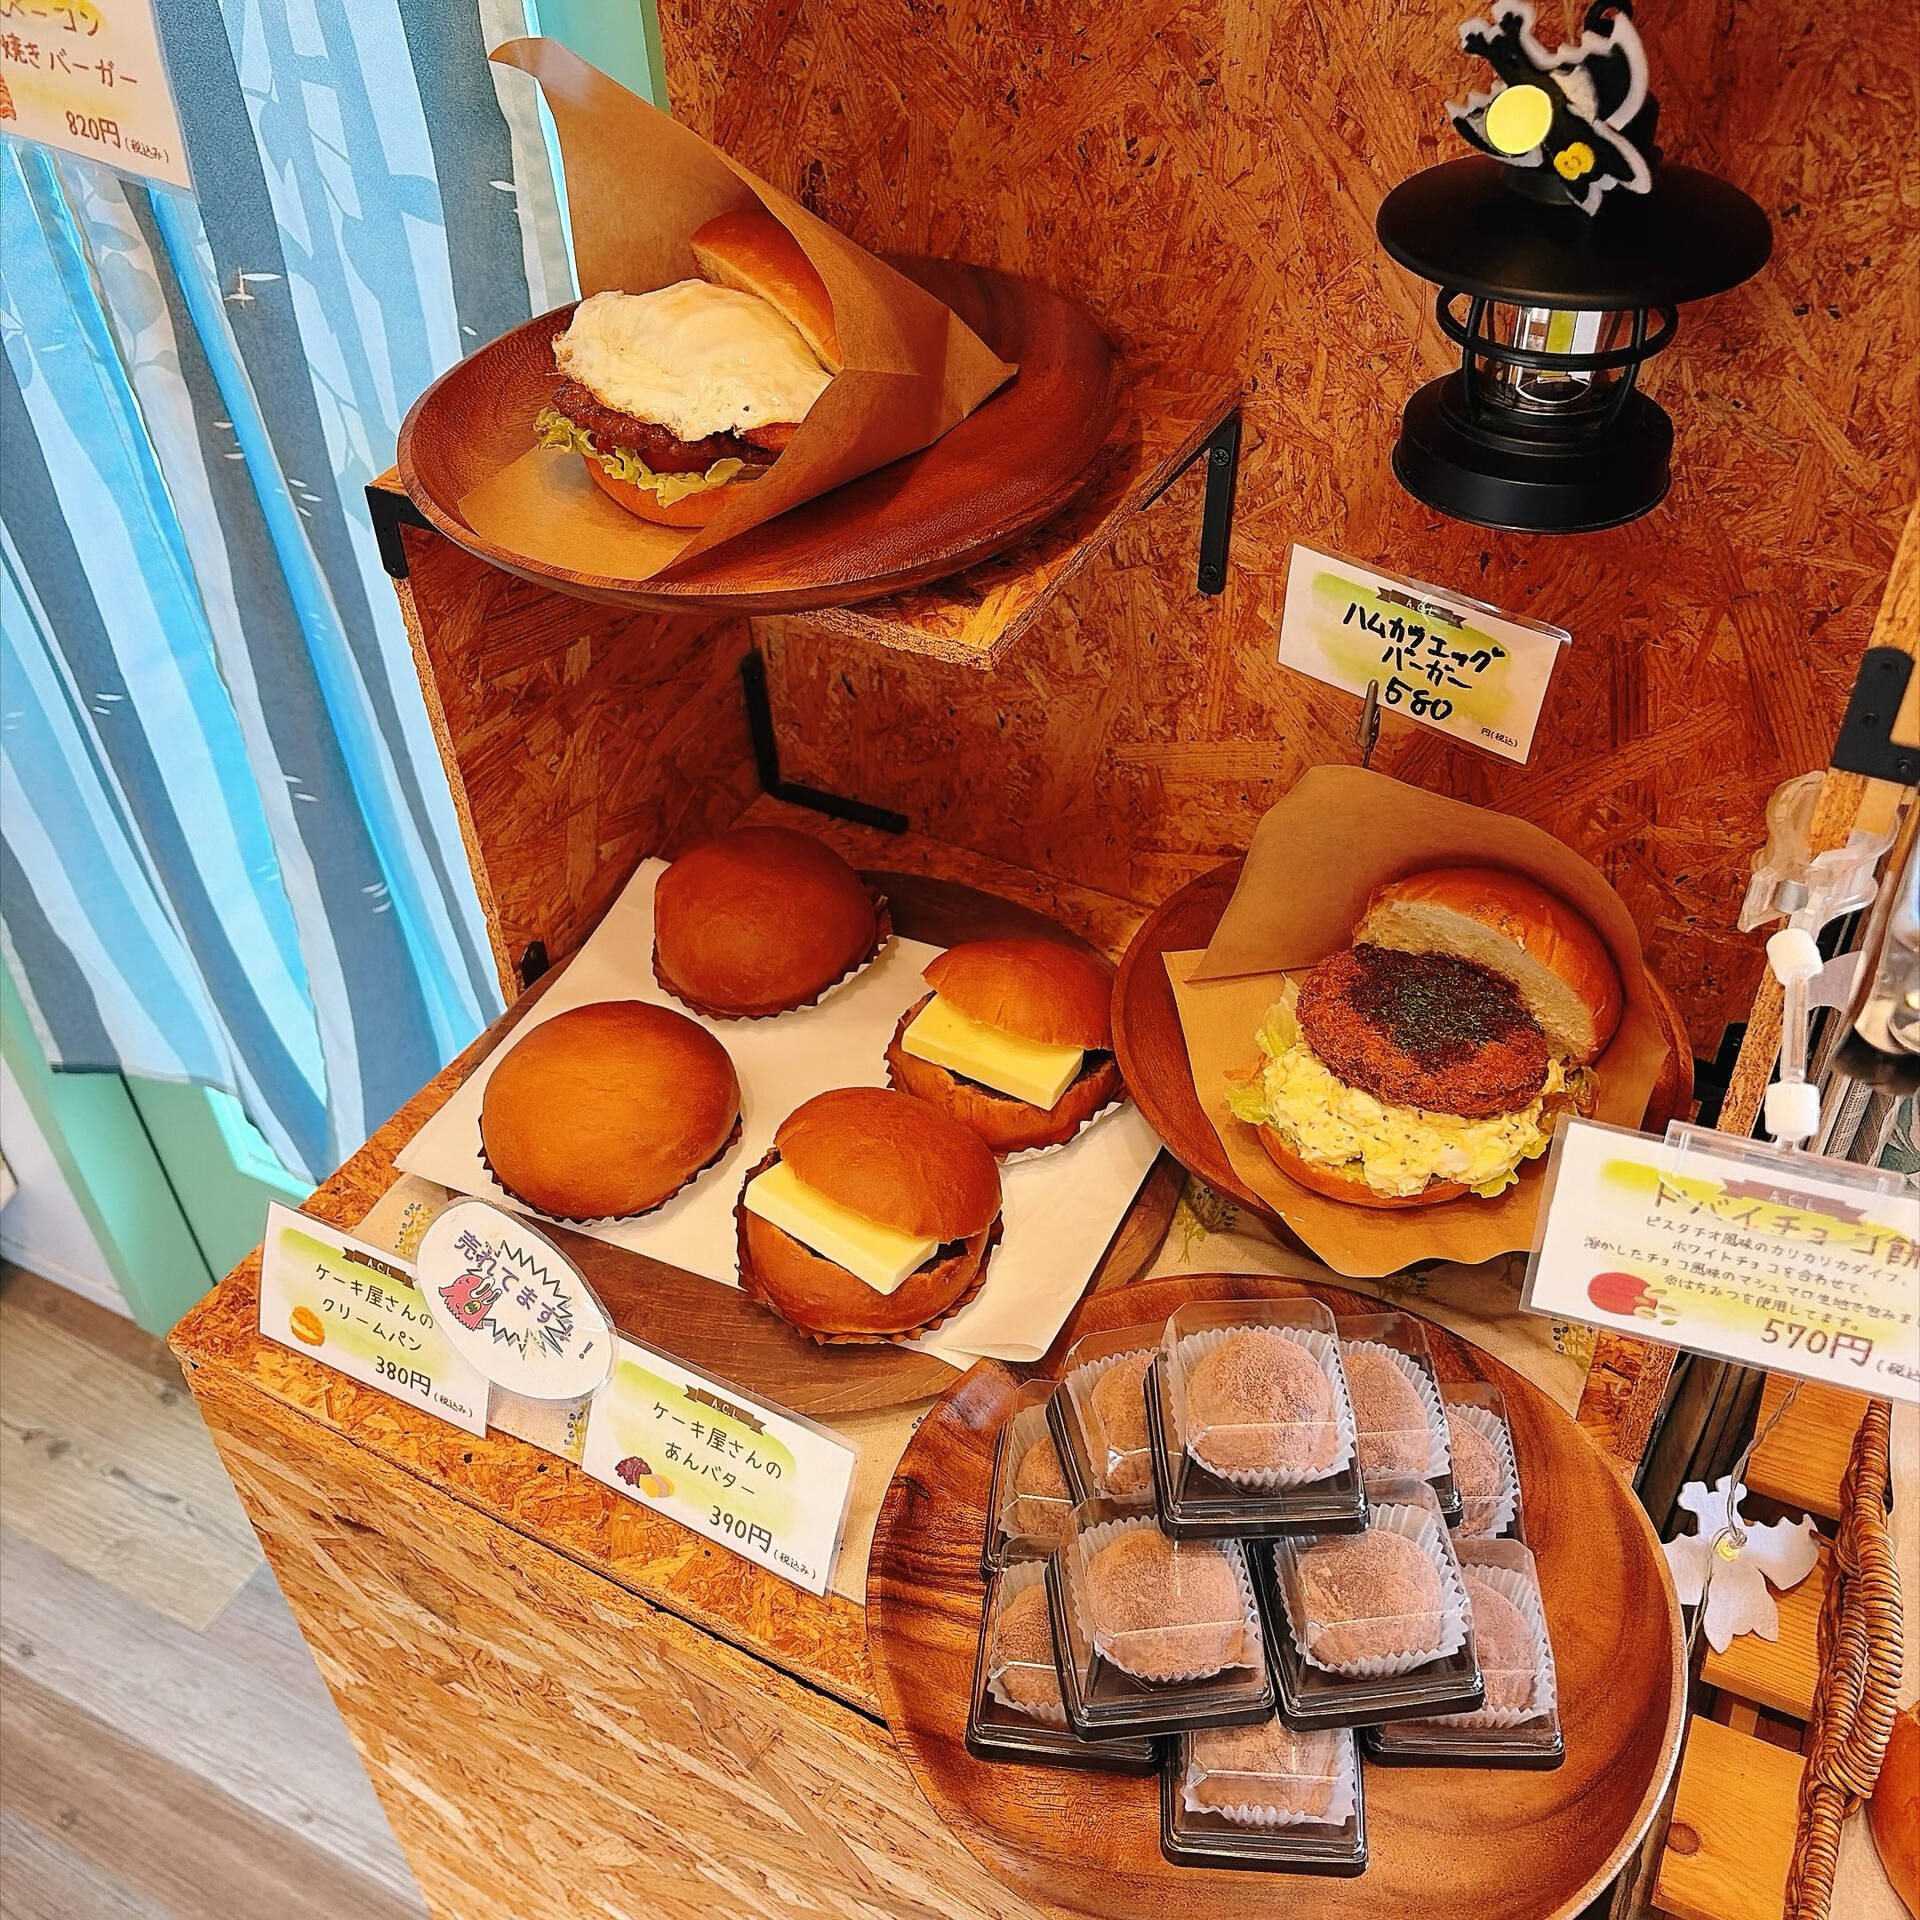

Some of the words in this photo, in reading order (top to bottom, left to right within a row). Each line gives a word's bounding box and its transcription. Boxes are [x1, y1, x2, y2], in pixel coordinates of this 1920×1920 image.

[0, 0, 99, 36] ベーコン
[65, 110, 122, 149] 820円
[1342, 602, 1506, 674] ハムカツエッグ
[1381, 645, 1473, 690] バーガー
[1384, 676, 1454, 721] 580
[1481, 727, 1519, 749] 円(税込)
[315, 1263, 434, 1330] ケーキ屋さんの
[1583, 1235, 1920, 1328] 溶かしたチョコ風味のマシュマロ生地で包みま
[322, 1298, 423, 1352] クリームパン
[1760, 1317, 1874, 1367] 570円
[375, 1355, 432, 1397] 380円
[653, 1401, 783, 1480] ケーキ屋さんの
[664, 1441, 756, 1496] あんバター
[709, 1505, 773, 1554] 390円
